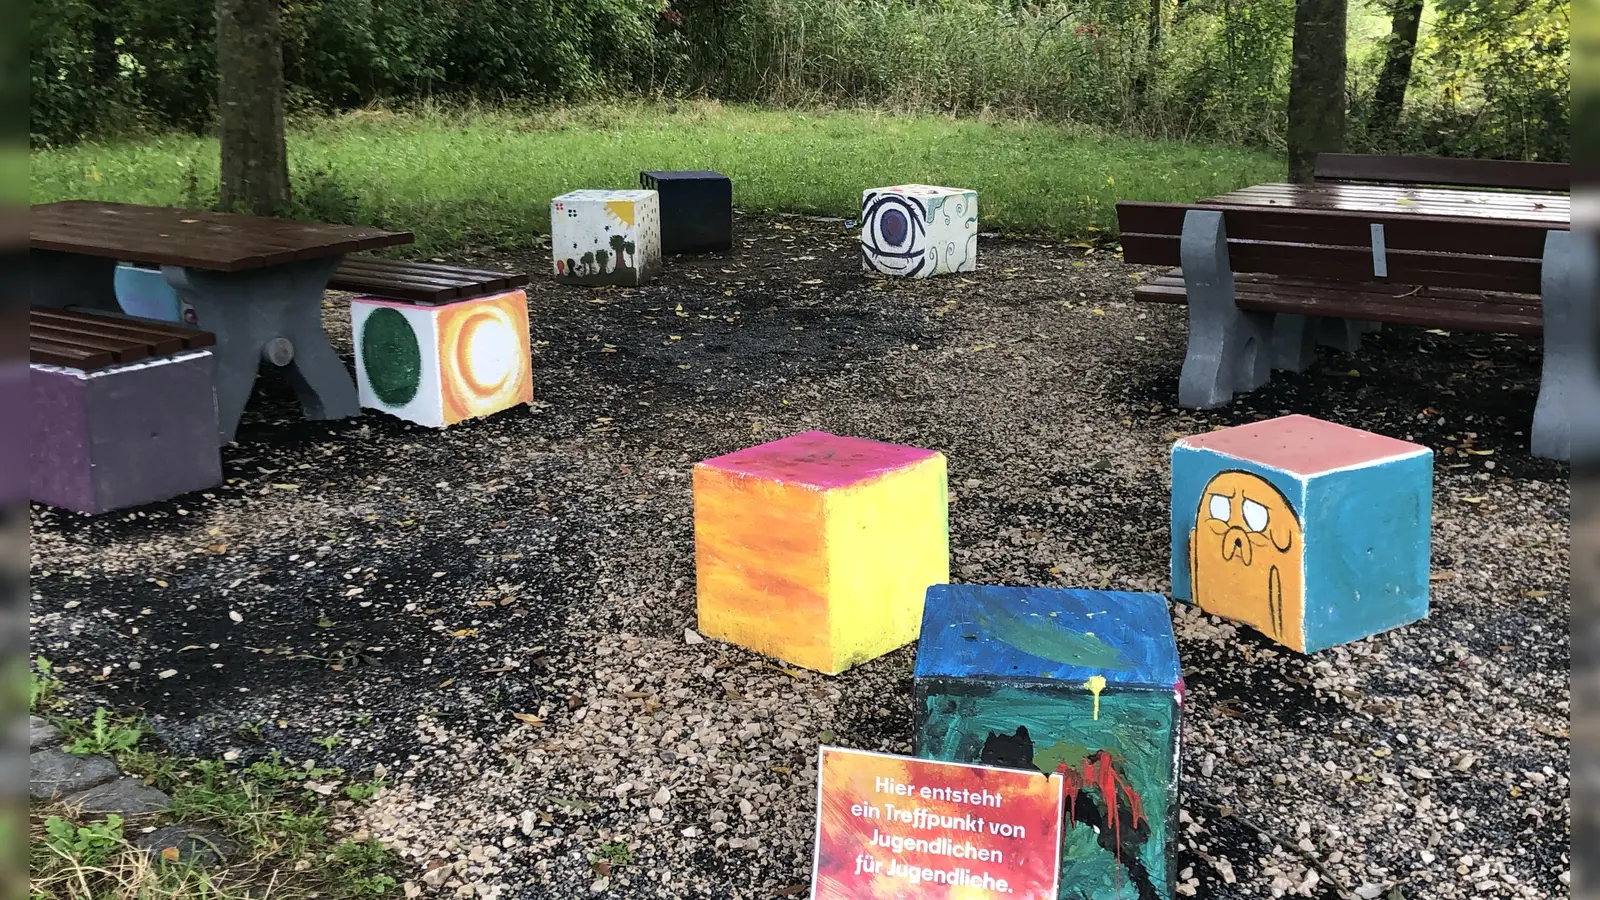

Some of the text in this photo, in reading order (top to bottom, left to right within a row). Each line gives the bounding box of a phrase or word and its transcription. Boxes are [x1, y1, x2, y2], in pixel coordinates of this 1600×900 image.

[875, 776, 1002, 808] Hier entsteht
[851, 802, 1026, 839] ein Treffpunkt von
[869, 829, 1003, 864] Jugendlichen
[855, 855, 1013, 893] für Jugendliche.
